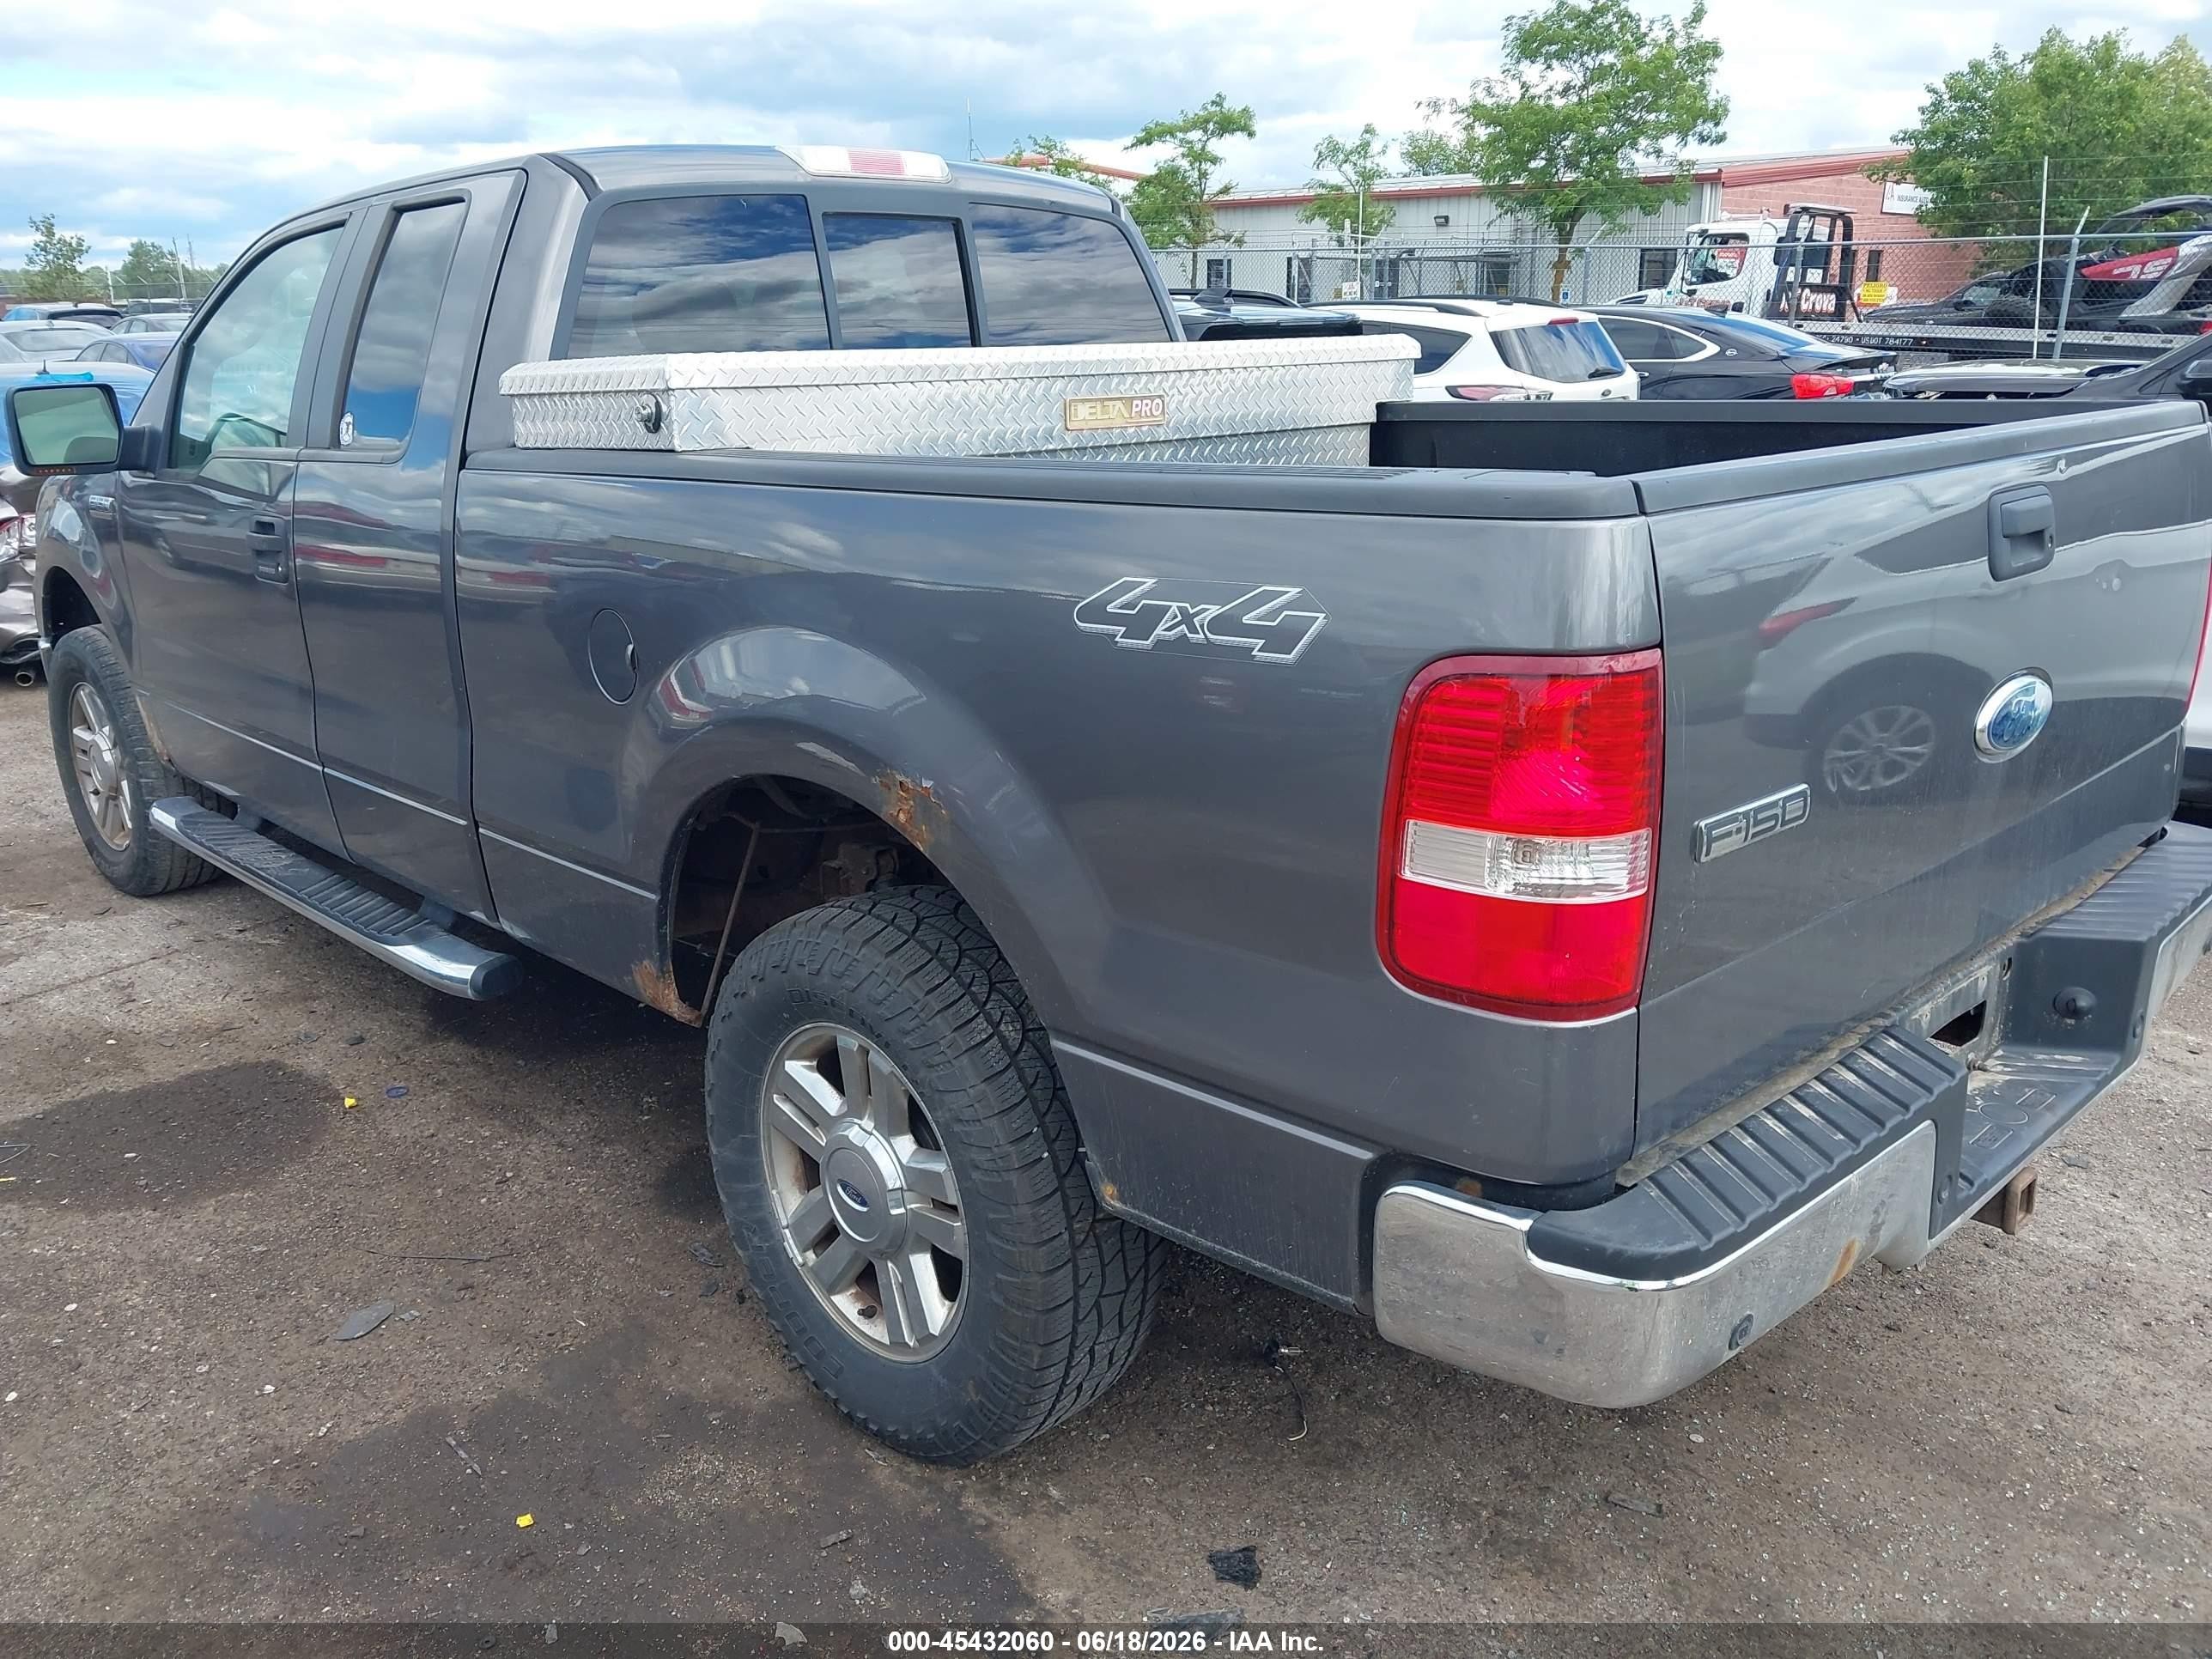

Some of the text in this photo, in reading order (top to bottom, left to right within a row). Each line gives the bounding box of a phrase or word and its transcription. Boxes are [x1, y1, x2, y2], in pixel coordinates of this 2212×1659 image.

[1801, 288, 1836, 313] Crova
[1885, 337, 1913, 346] 784177
[1070, 398, 1164, 421] DELTA PRO
[845, 1186, 863, 1204] Ford
